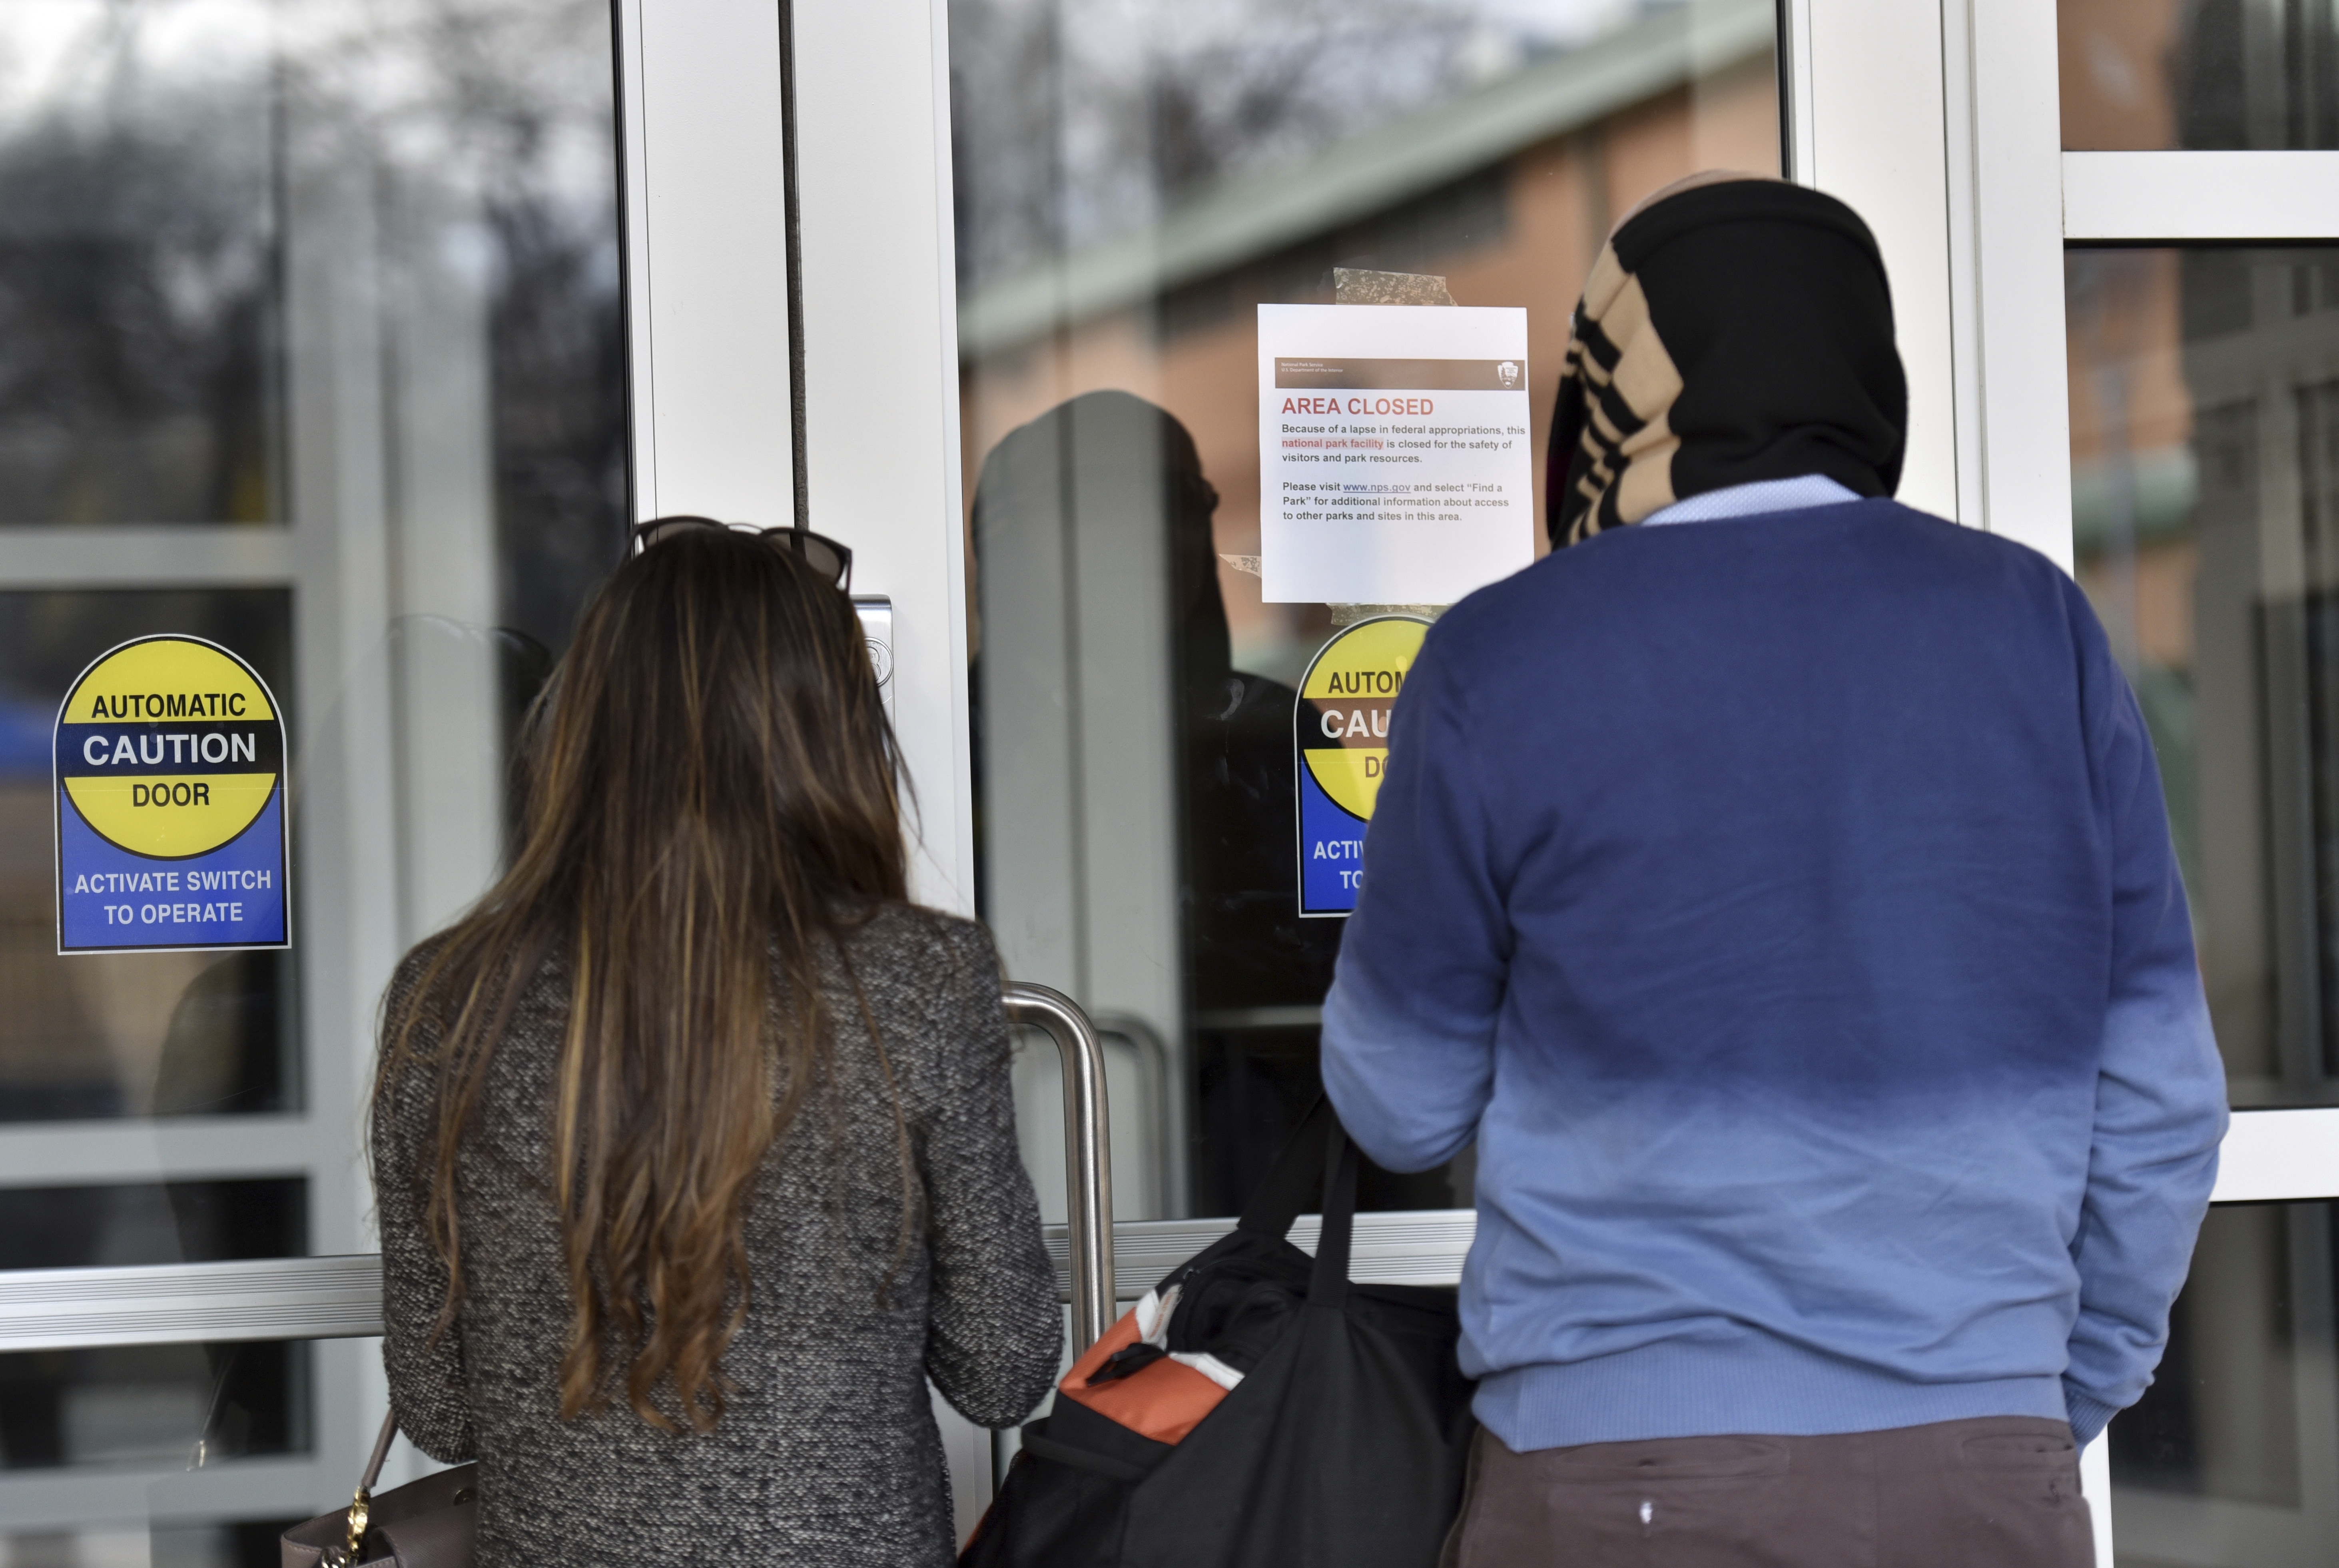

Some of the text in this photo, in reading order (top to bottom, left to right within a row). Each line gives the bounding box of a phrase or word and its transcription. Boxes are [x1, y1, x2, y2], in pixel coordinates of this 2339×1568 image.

[1282, 398, 1433, 415] AREA CLOSED
[1282, 424, 1325, 433] Because
[1328, 425, 1338, 433] of
[1350, 425, 1376, 435] lapse
[1392, 425, 1425, 433] federal
[1429, 426, 1504, 436] appropriations,
[1282, 439, 1512, 451] national park facility is closed for the safety of
[1282, 453, 1320, 462] visitors
[1323, 453, 1341, 462] and
[1345, 454, 1366, 464] park
[1283, 482, 1316, 491] Please
[1320, 482, 1340, 491] visit
[1343, 485, 1410, 493] www.nps.gov
[1414, 483, 1432, 491] and
[1435, 483, 1464, 492] select
[1468, 483, 1493, 492] “Find
[1283, 497, 1310, 505] Park”
[1314, 497, 1328, 505] for
[1332, 497, 1380, 506] additional
[1384, 497, 1440, 506] information
[1444, 498, 1471, 506] about
[1296, 511, 1323, 520] other
[1326, 511, 1353, 522] parks
[1357, 512, 1374, 520] and
[1378, 512, 1401, 520] sites
[1328, 671, 1409, 694] AUTOM
[92, 693, 246, 718] AUTOMATIC
[83, 733, 255, 766] CAUTION
[133, 782, 209, 807] DOOR
[74, 870, 271, 894] ACTIVATE SWITCH
[104, 902, 243, 925] TO OPERATE
